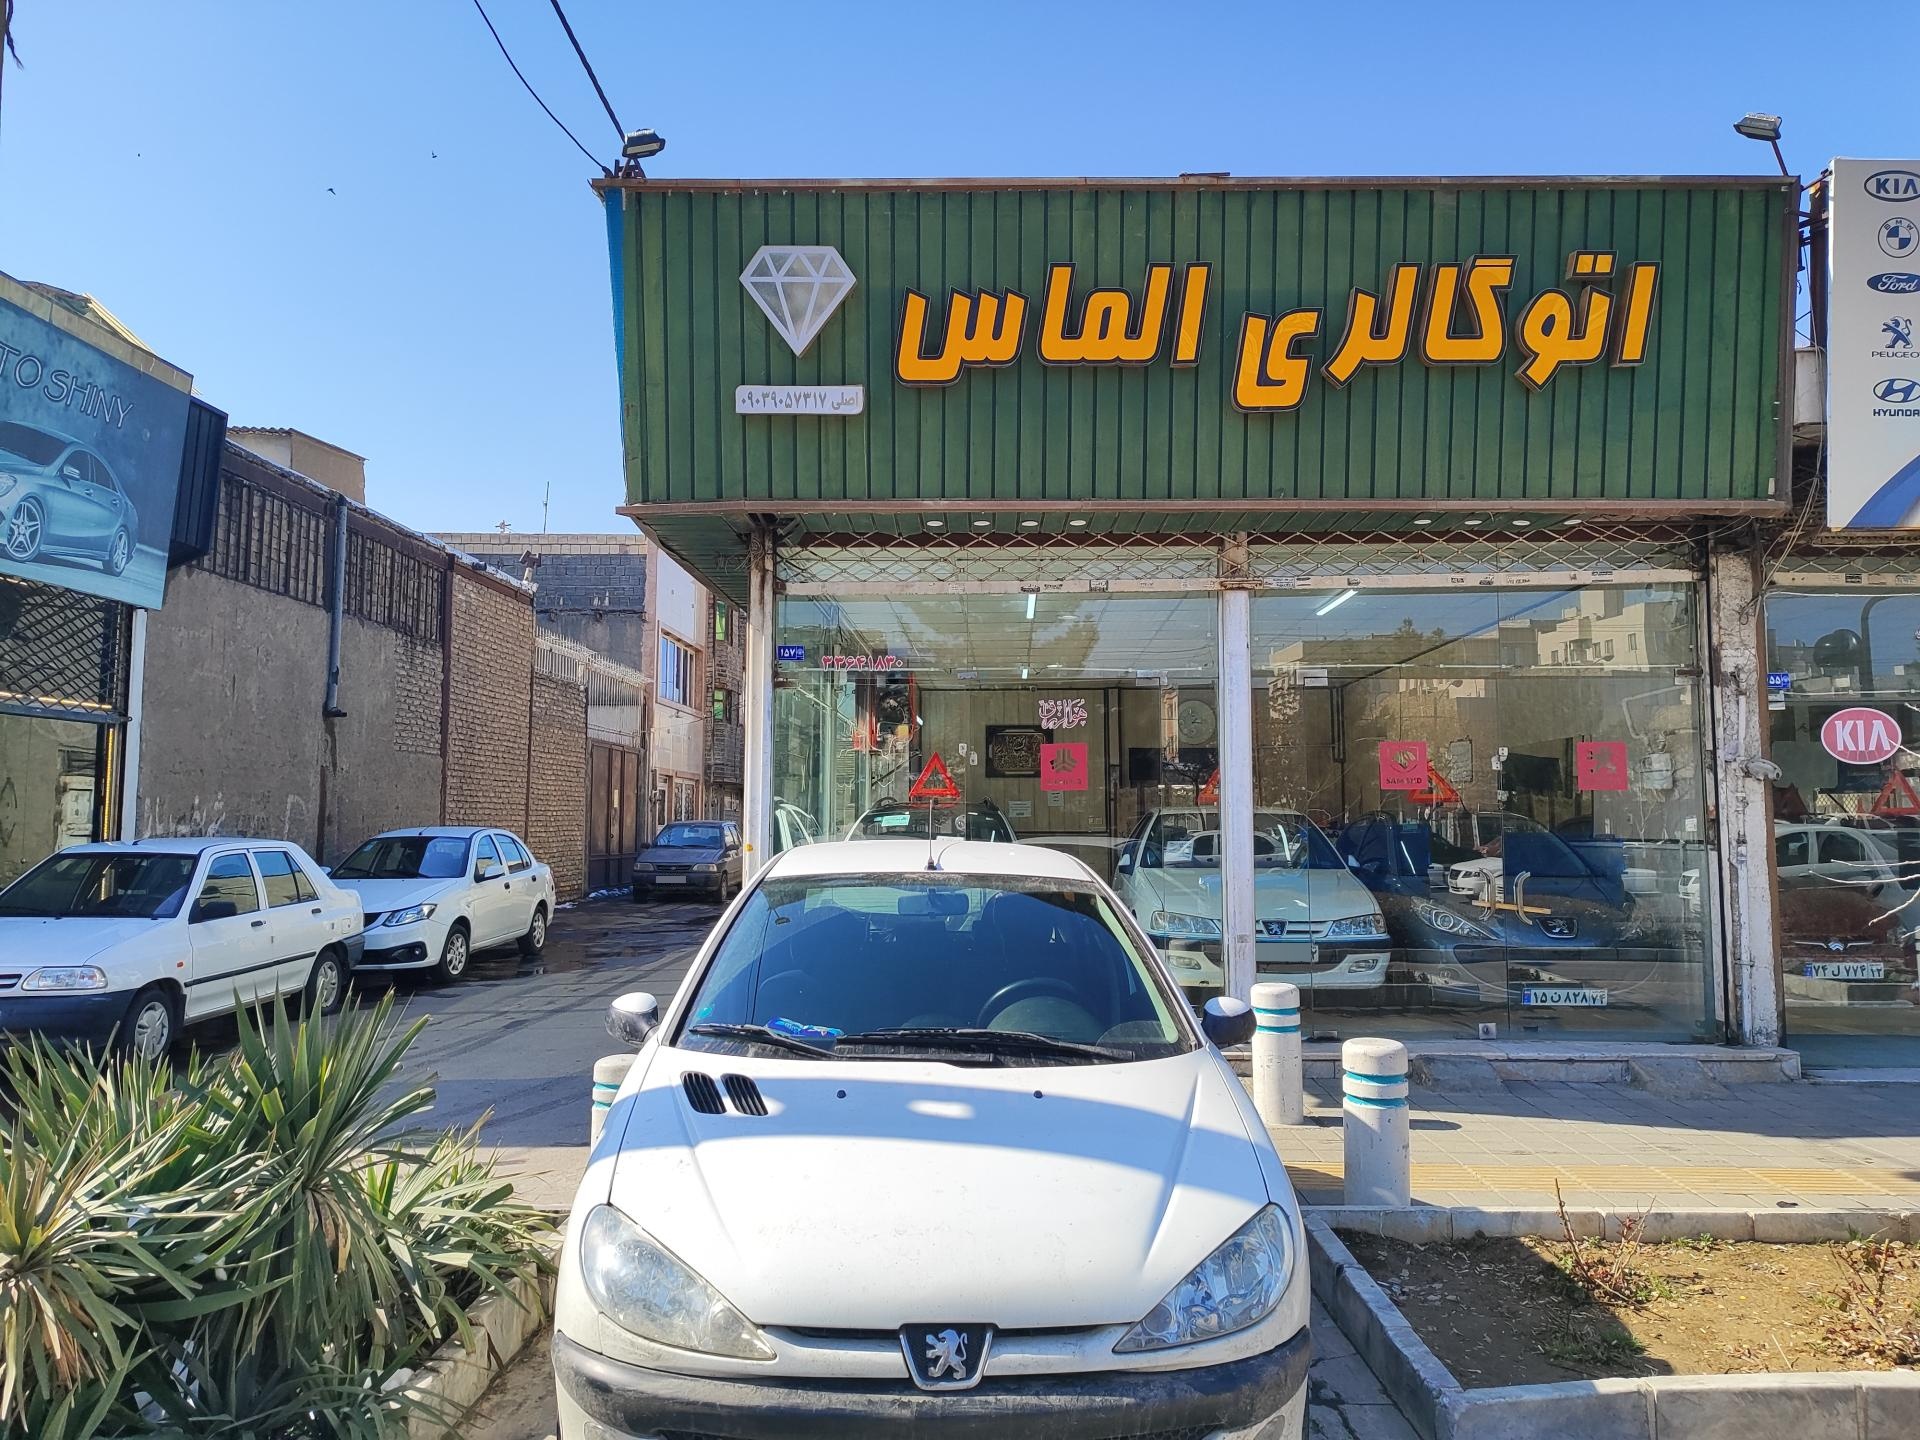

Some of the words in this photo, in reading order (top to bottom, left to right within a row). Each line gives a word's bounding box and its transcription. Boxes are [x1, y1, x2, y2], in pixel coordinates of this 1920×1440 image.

[1875, 178, 1918, 194] KIA
[1884, 220, 1914, 231] BMW
[1878, 274, 1918, 291] Ford
[893, 261, 1214, 387] الماس
[741, 391, 827, 408] ۰۹۰۳۹۰۵۷۳۱۷
[831, 391, 859, 410] اصلی
[780, 648, 796, 657] ۱۵۷
[822, 655, 904, 672] ۳۳۶۴۱۸۳۰
[1767, 675, 1781, 685] ۵۵
[1834, 720, 1891, 751] KIA
[1533, 991, 1548, 1004] ۱۵
